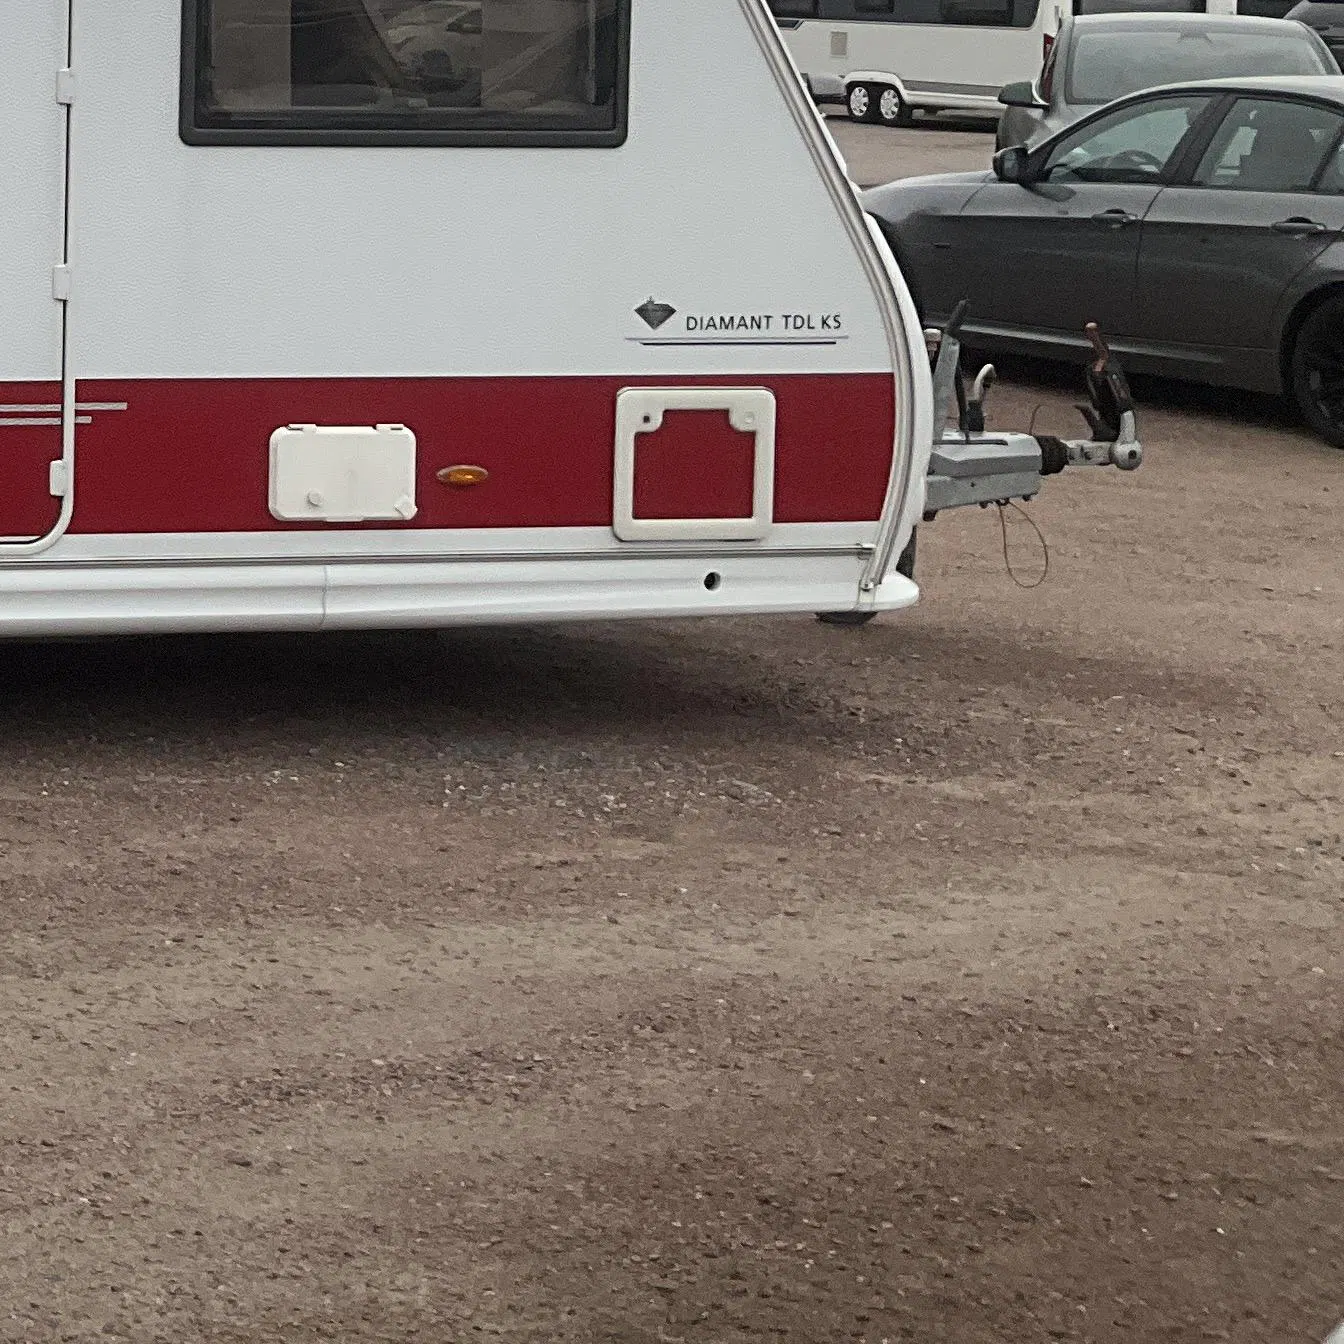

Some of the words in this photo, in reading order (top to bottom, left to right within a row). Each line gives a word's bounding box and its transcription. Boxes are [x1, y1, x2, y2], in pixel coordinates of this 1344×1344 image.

[686, 315, 773, 331] DIAMANT
[782, 314, 815, 330] TDL
[821, 314, 842, 329] KS
